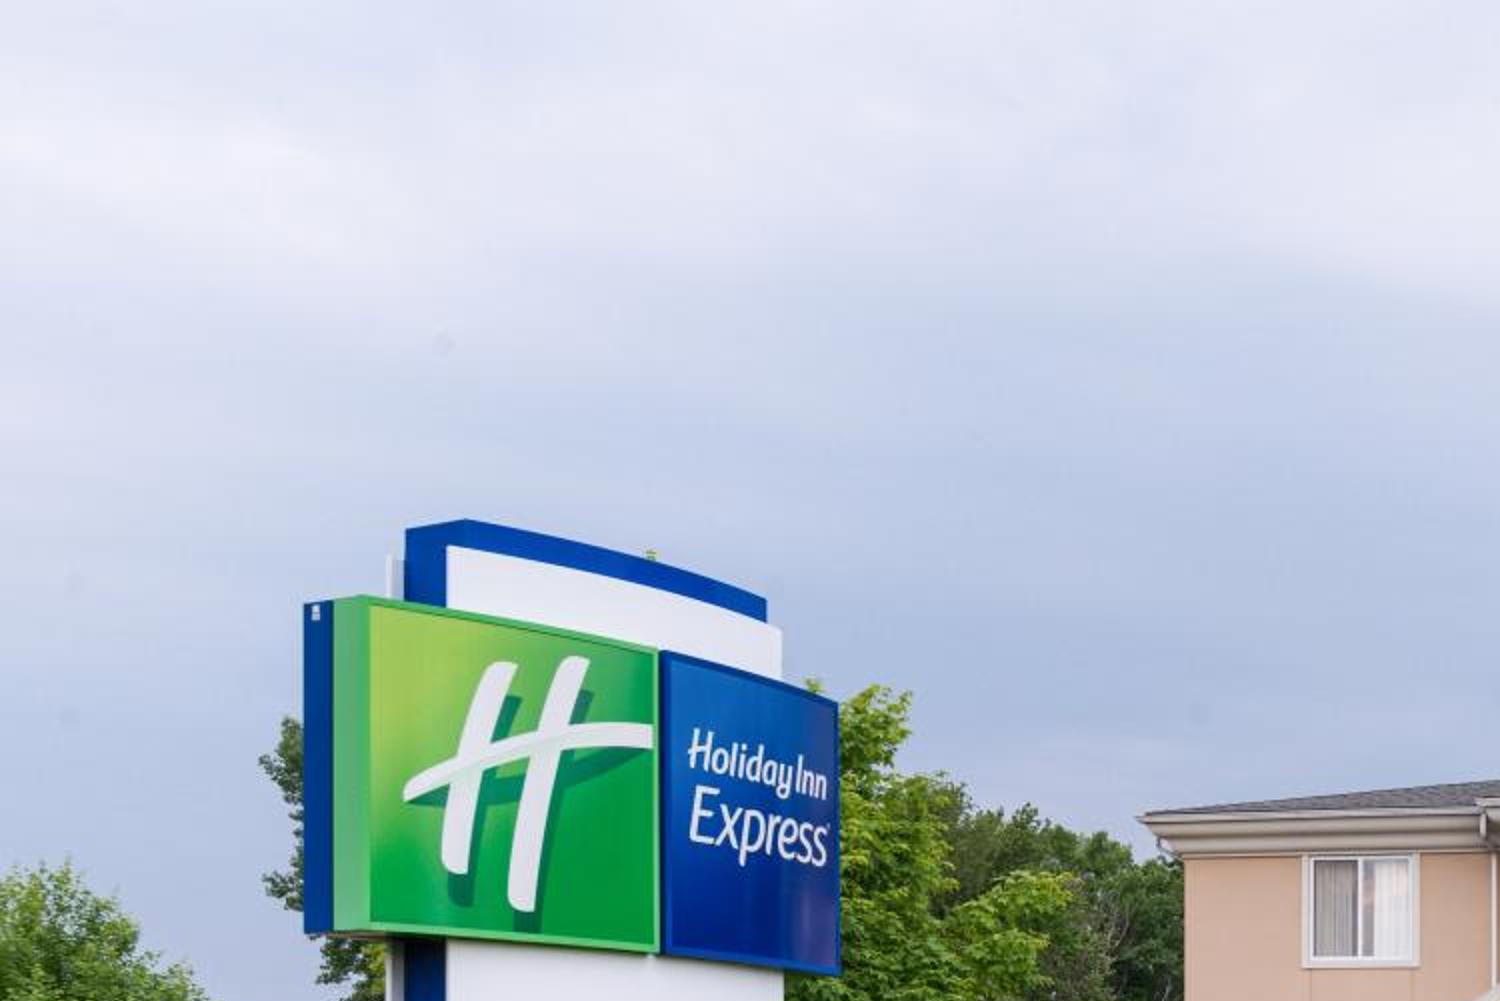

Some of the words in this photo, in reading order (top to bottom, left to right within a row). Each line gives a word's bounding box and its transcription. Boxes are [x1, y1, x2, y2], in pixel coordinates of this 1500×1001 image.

[403, 655, 654, 913] H
[688, 727, 794, 800] Holiday
[795, 754, 827, 800] Inn
[690, 784, 827, 867] Express
